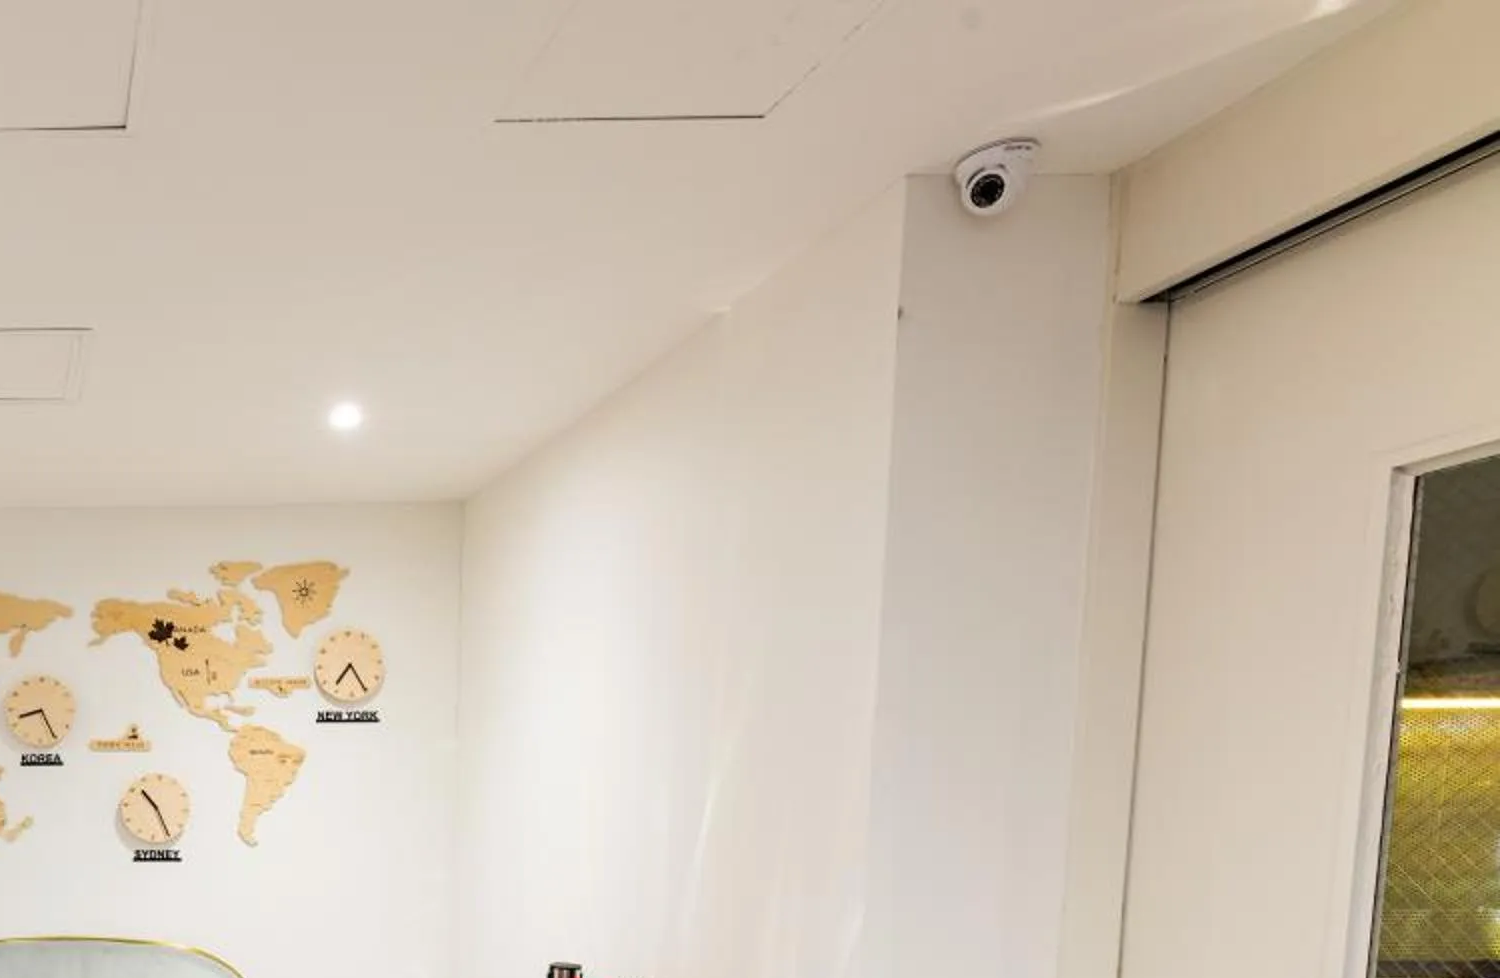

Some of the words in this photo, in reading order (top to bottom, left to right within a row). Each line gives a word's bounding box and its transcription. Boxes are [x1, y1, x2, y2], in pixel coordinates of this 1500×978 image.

[317, 711, 343, 721] NEW
[345, 711, 378, 721] YORK
[21, 753, 62, 765] KOREA
[134, 849, 181, 861] SYDNEY
